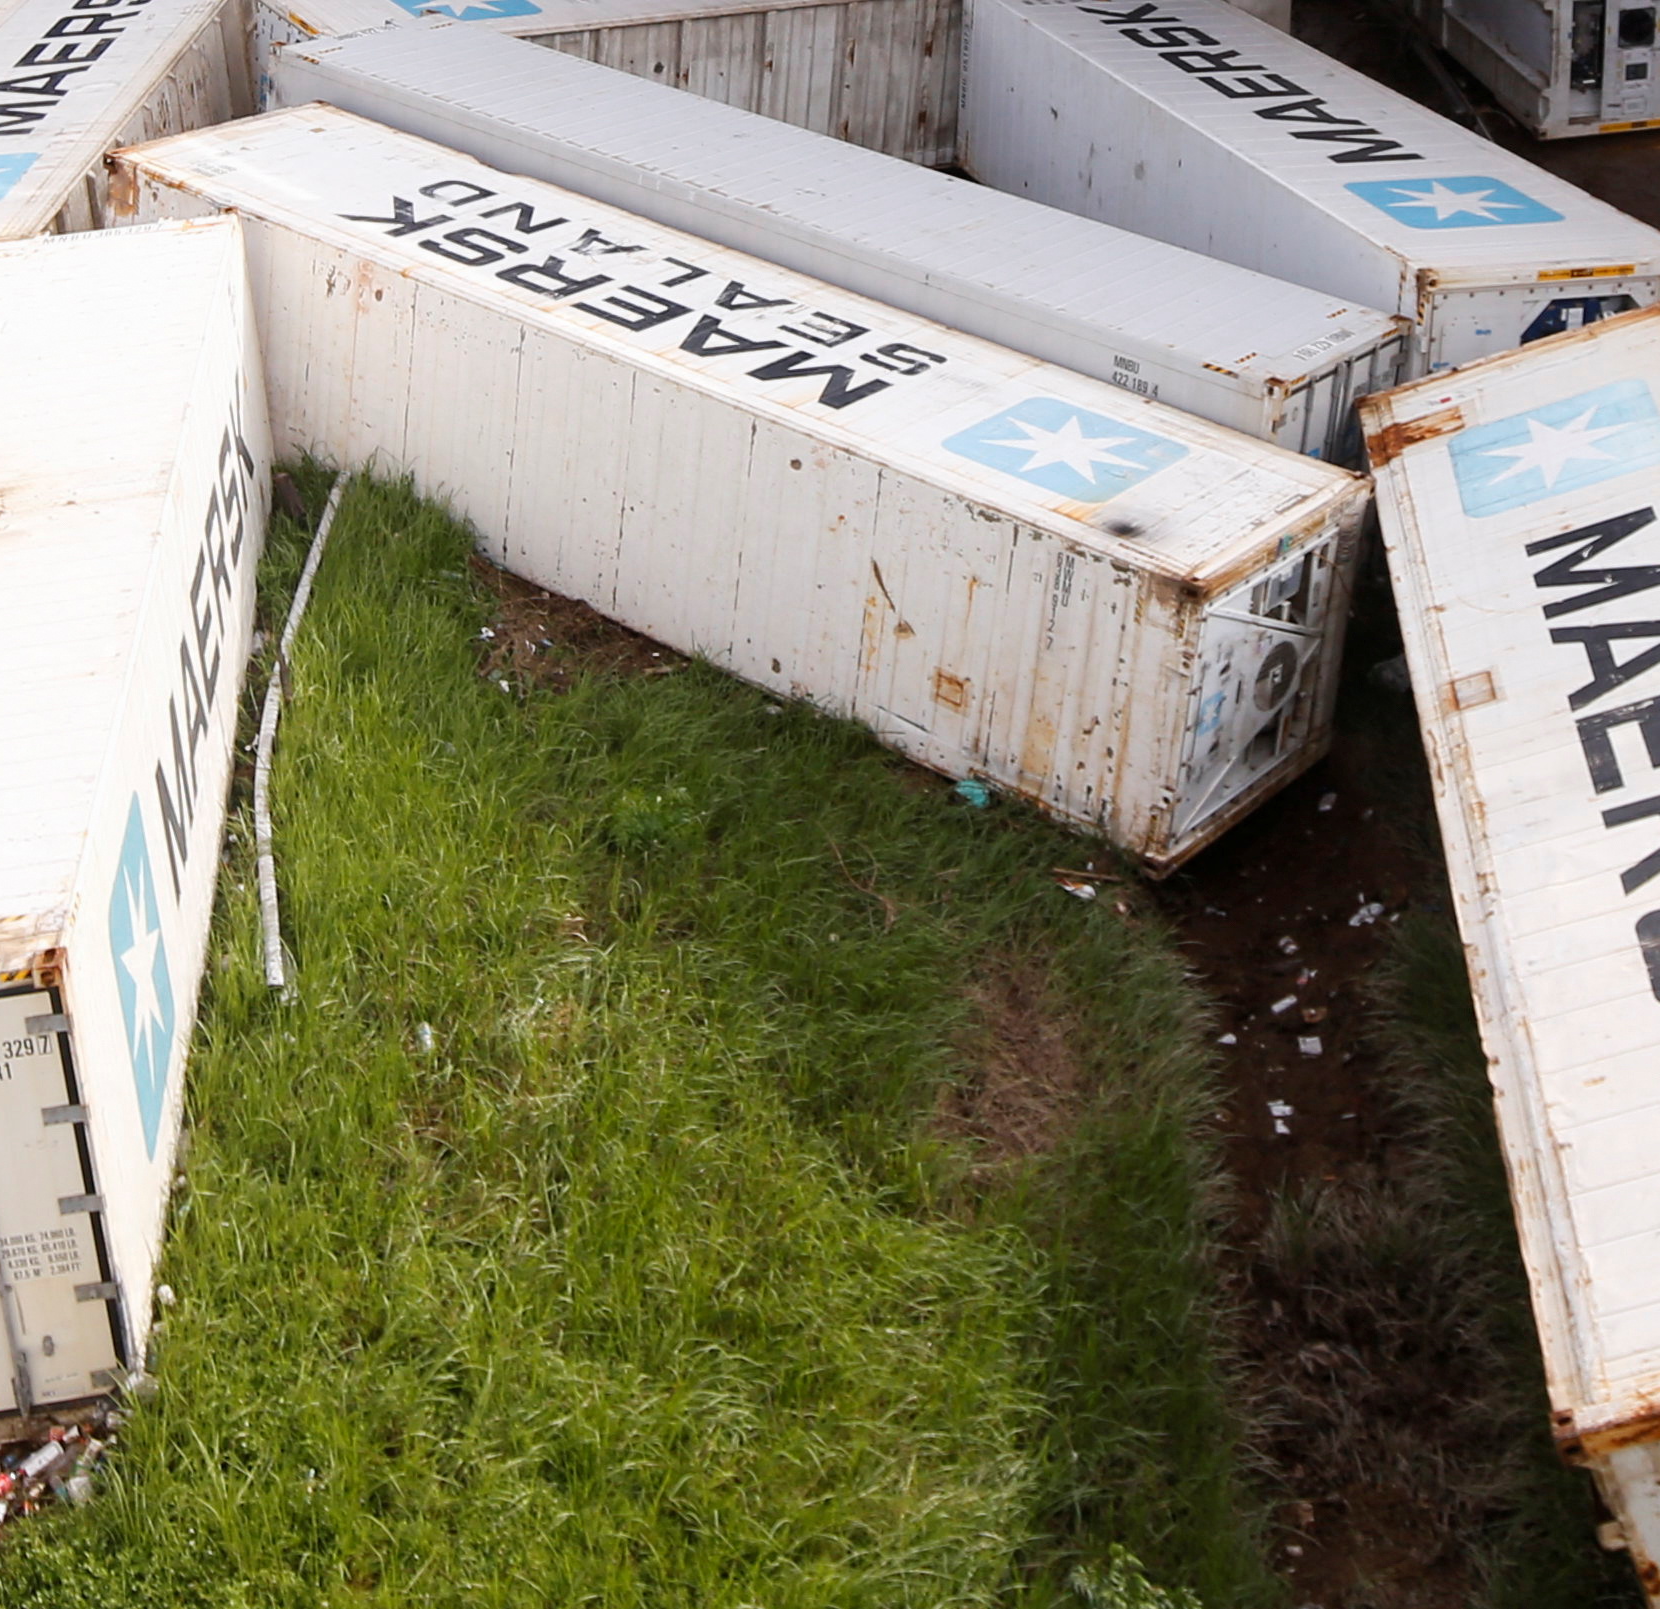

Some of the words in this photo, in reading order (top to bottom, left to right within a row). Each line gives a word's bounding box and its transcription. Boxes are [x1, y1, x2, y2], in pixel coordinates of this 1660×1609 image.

[1078, 2, 1423, 165] MAERSK
[339, 196, 894, 410] MAERSK
[420, 180, 947, 376] SEALAND
[1112, 371, 1130, 388] 422
[1132, 377, 1149, 395] 189
[1113, 353, 1140, 374] MNBU
[155, 374, 256, 907] MAERSK
[2, 1038, 36, 1061] 329
[37, 1035, 51, 1057] 7
